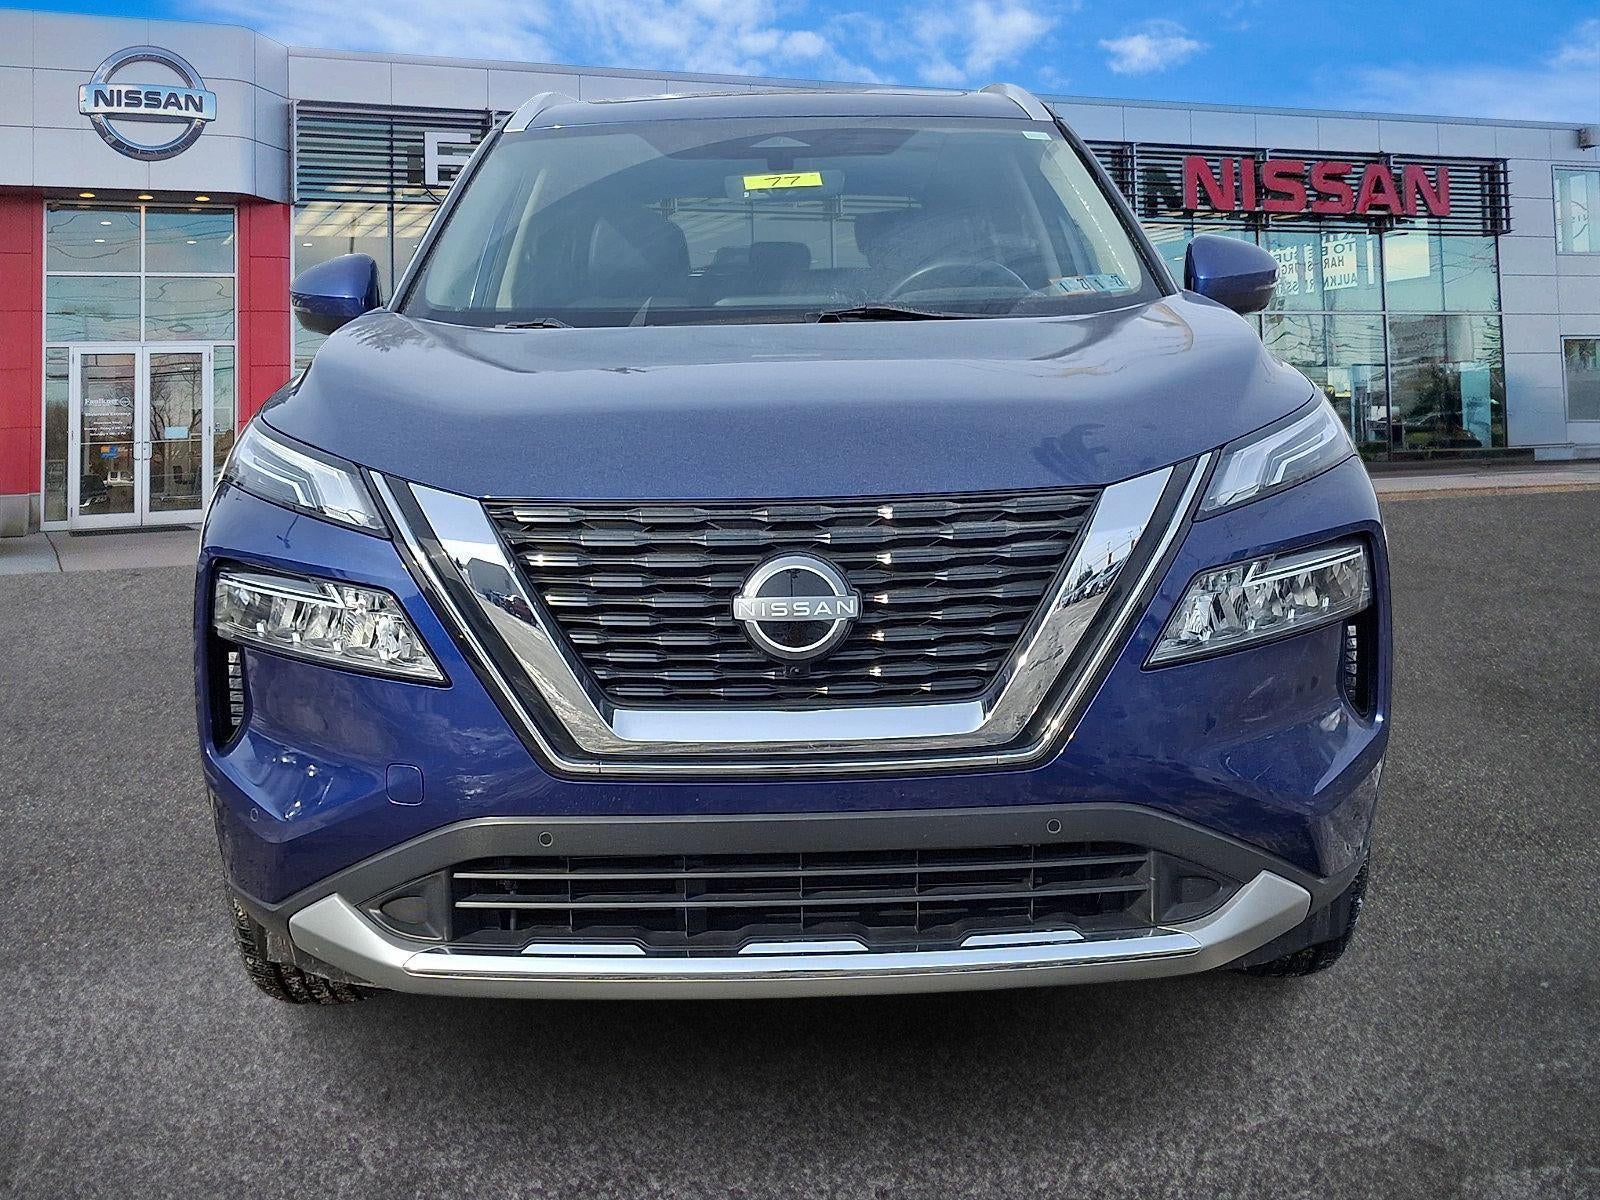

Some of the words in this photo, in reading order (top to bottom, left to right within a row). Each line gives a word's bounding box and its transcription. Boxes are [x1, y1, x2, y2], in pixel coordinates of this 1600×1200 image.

[94, 89, 203, 113] NISSAN
[764, 176, 801, 187] 77
[1182, 155, 1451, 216] NISSAN
[738, 600, 854, 617] NISSAN
